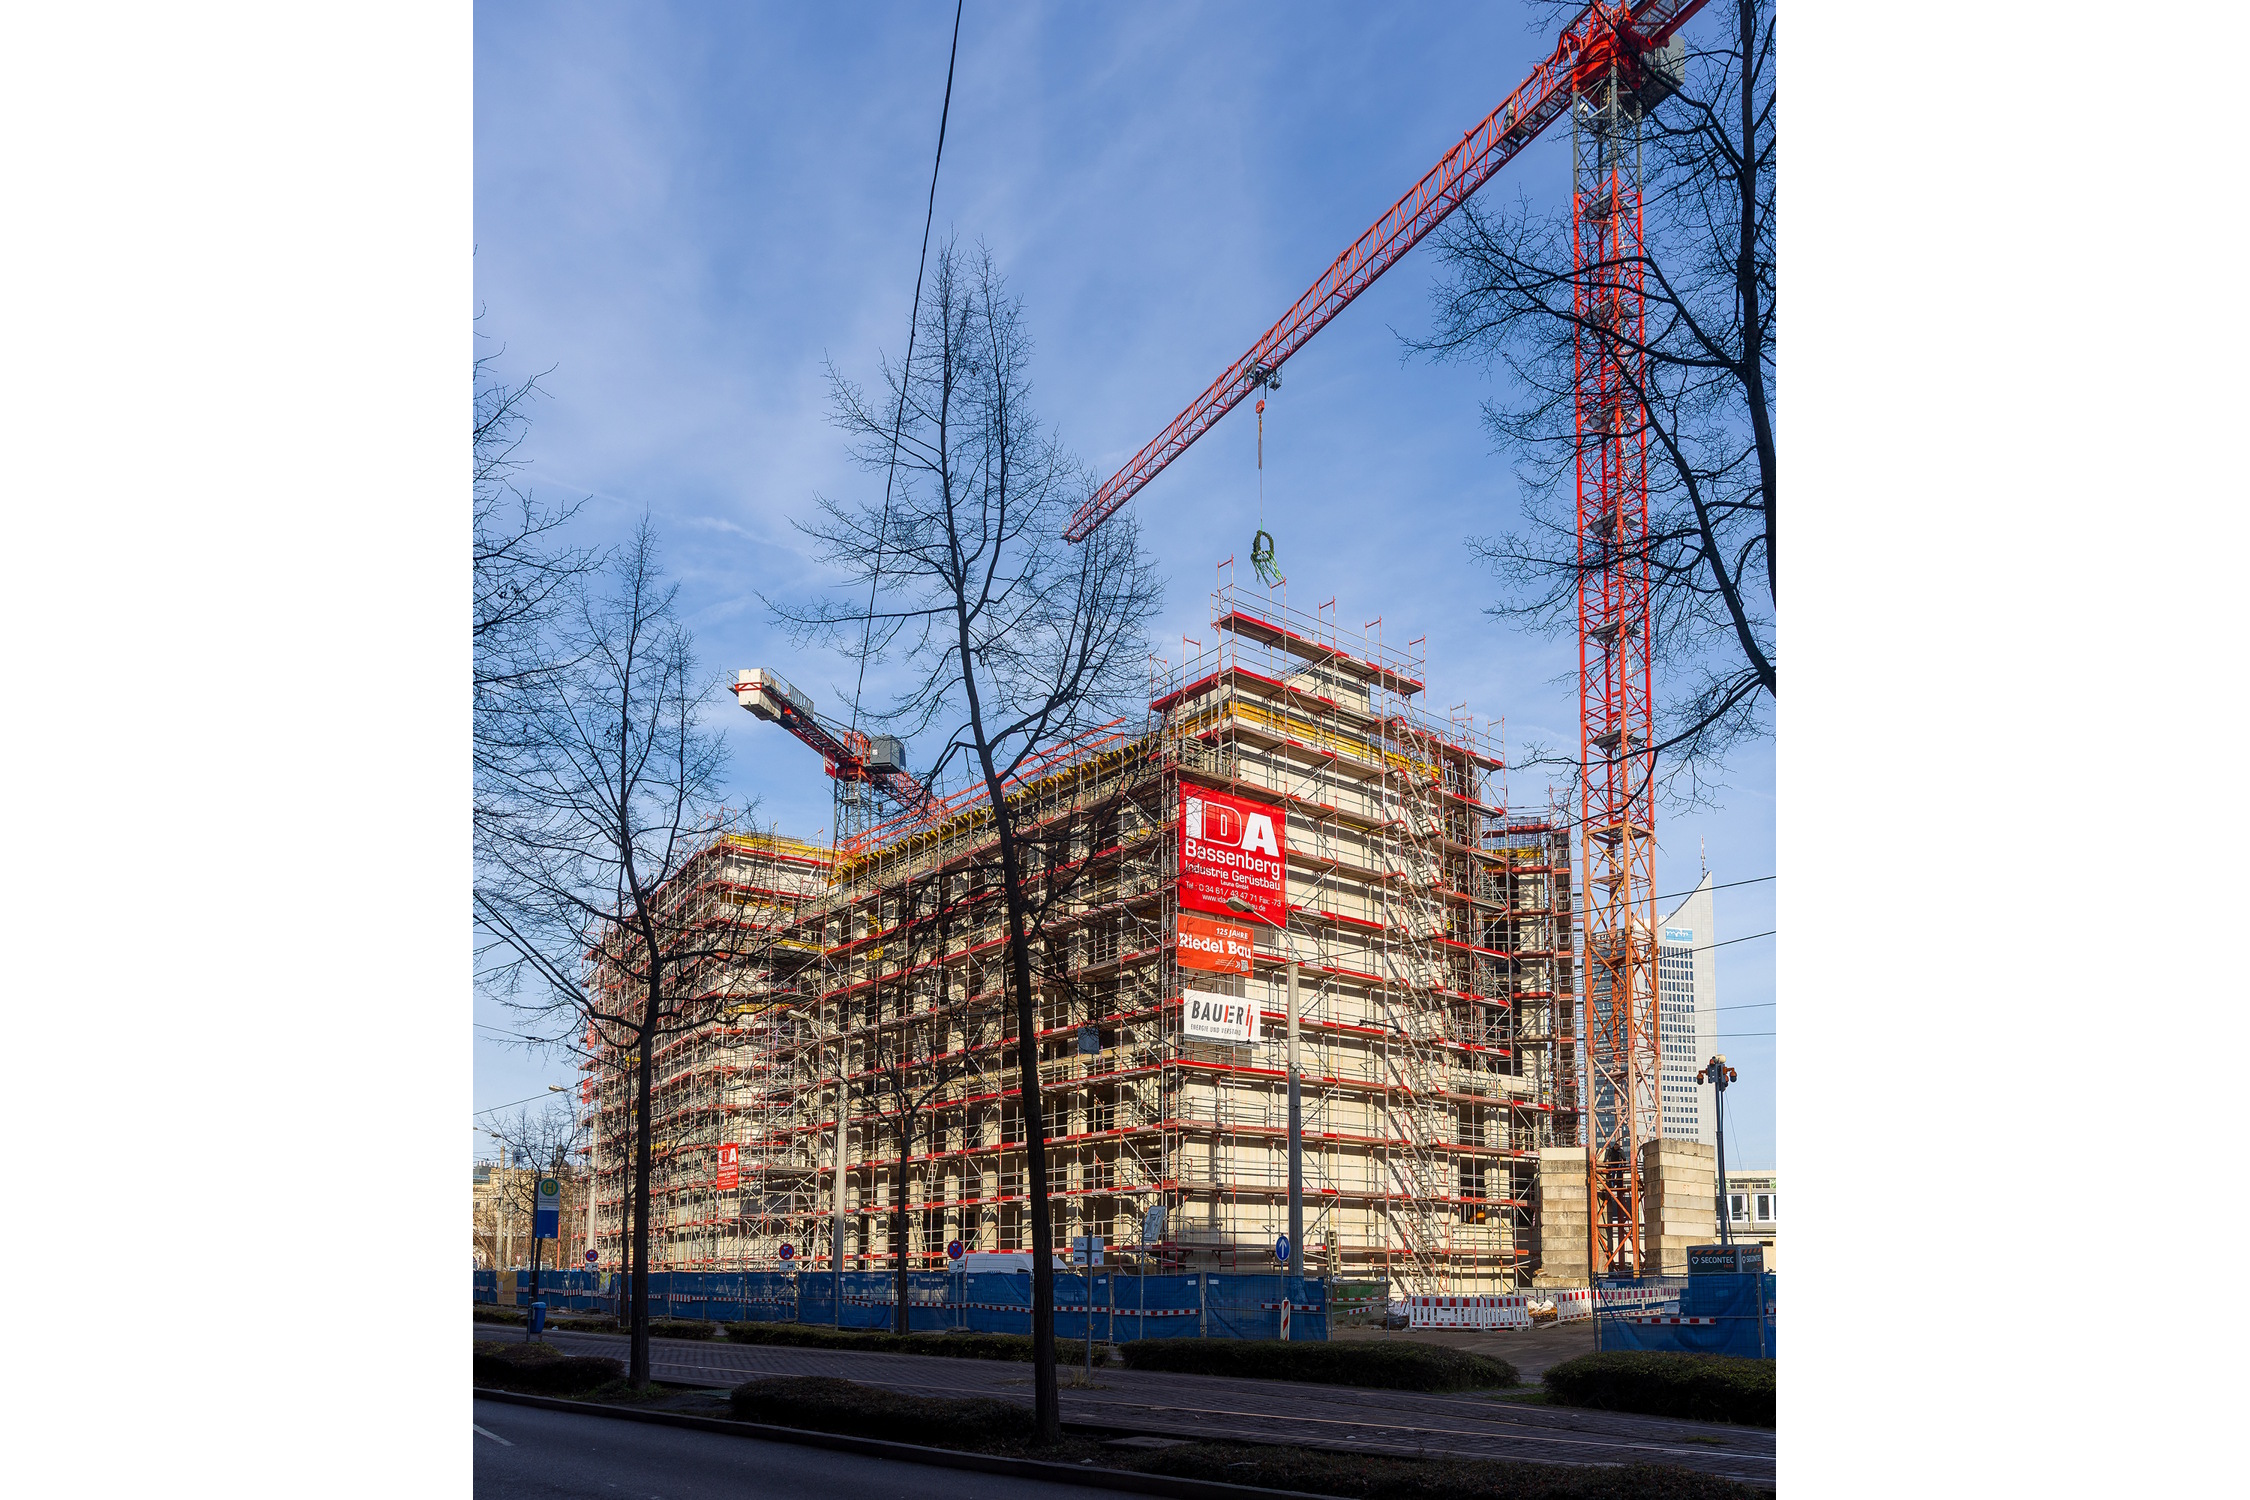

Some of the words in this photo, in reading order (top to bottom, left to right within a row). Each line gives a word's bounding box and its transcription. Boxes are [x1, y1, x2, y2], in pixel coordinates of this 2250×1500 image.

[1185, 796, 1279, 857] IDA
[1185, 838, 1280, 880] Bassenberg
[1185, 860, 1229, 880] Industrie
[1231, 870, 1280, 891] Gerüstbau
[1205, 885, 1214, 894] 34
[1230, 889, 1239, 898] 43
[1240, 891, 1248, 900] 47
[1250, 893, 1257, 902] 71
[1216, 927, 1228, 936] 125
[1228, 929, 1248, 940] JAHRE
[1178, 932, 1224, 954] Riedel
[1227, 940, 1252, 959] Bau
[1191, 1000, 1244, 1026] BAUER
[1190, 1023, 1209, 1032] ENERGIE
[1210, 1026, 1220, 1034] UND
[1221, 1027, 1242, 1036] VERSTAND
[718, 1147, 737, 1165] IDA
[1700, 1256, 1734, 1264] SECONTEC
